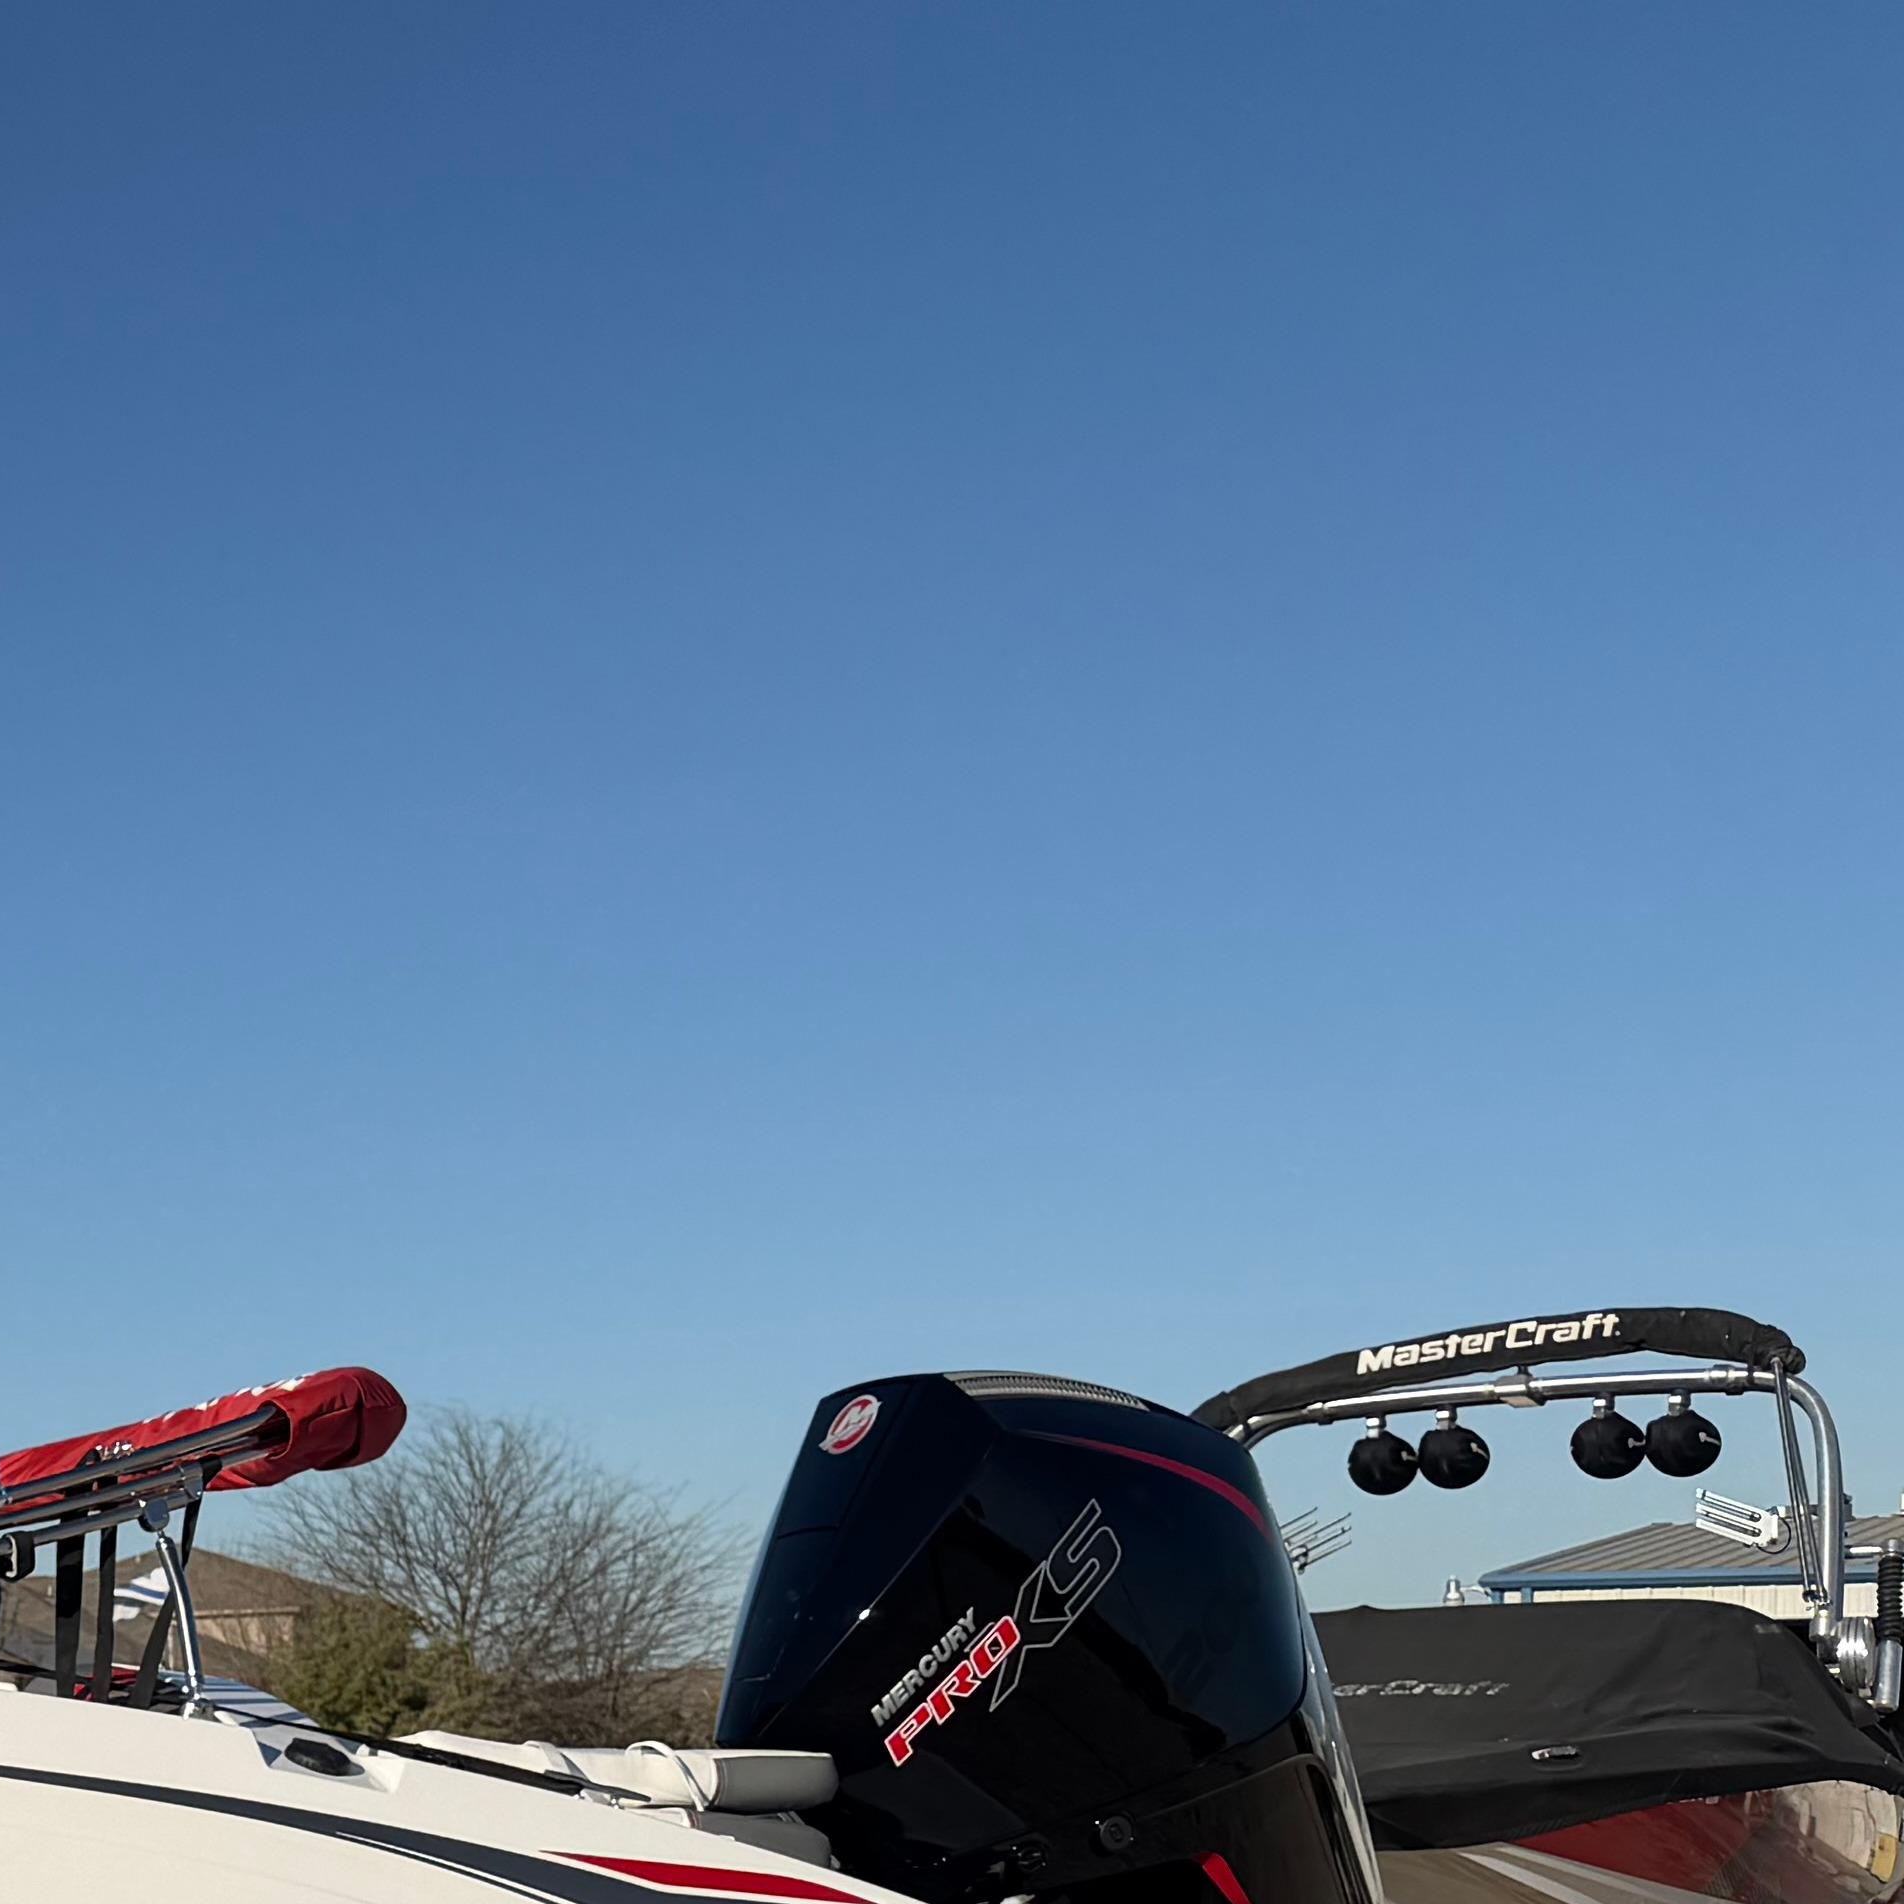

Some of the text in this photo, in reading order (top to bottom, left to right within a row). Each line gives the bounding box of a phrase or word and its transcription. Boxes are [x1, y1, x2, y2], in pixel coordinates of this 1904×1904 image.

[870, 1606, 977, 1728] MERCURY
[884, 1498, 1122, 1767] PRO XS
